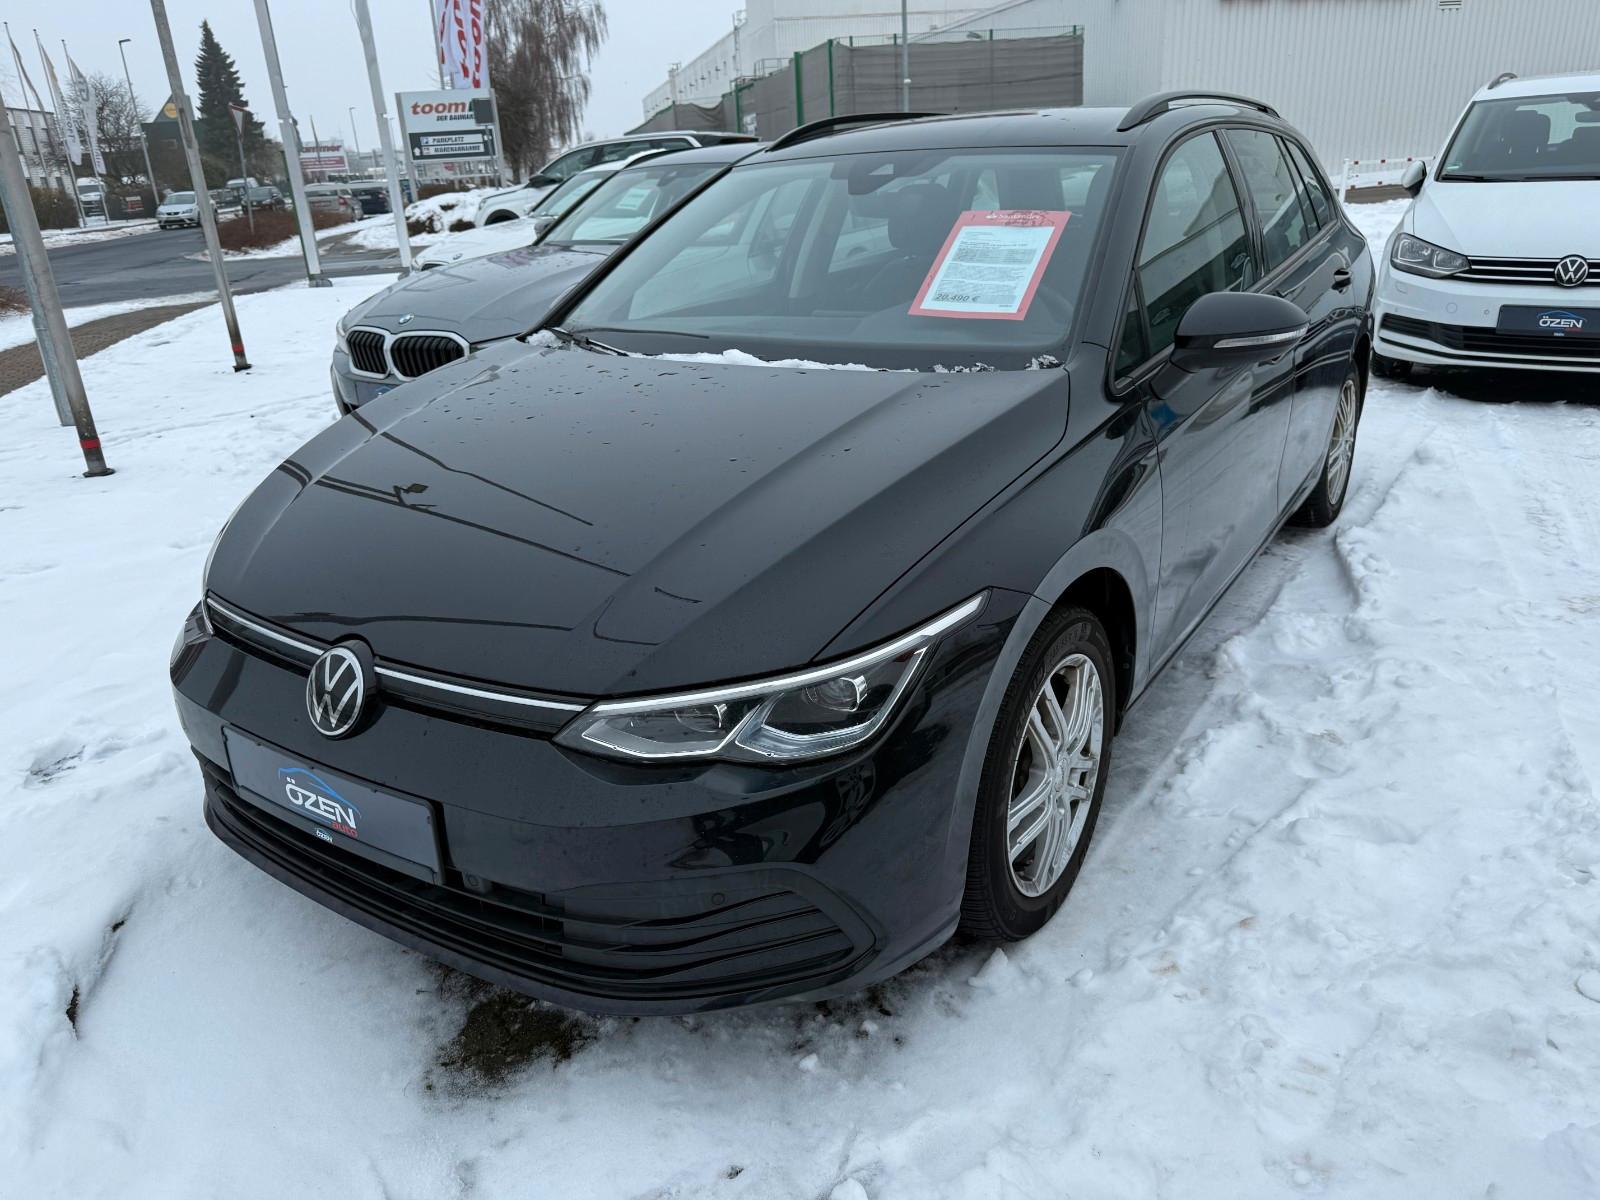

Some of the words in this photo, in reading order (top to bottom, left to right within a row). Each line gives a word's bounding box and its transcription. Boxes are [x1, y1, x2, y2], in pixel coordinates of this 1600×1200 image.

[411, 102, 466, 115] toom
[1539, 315, 1583, 328] ÖZEN
[285, 776, 357, 829] ÖZEN
[331, 821, 358, 839] auto
